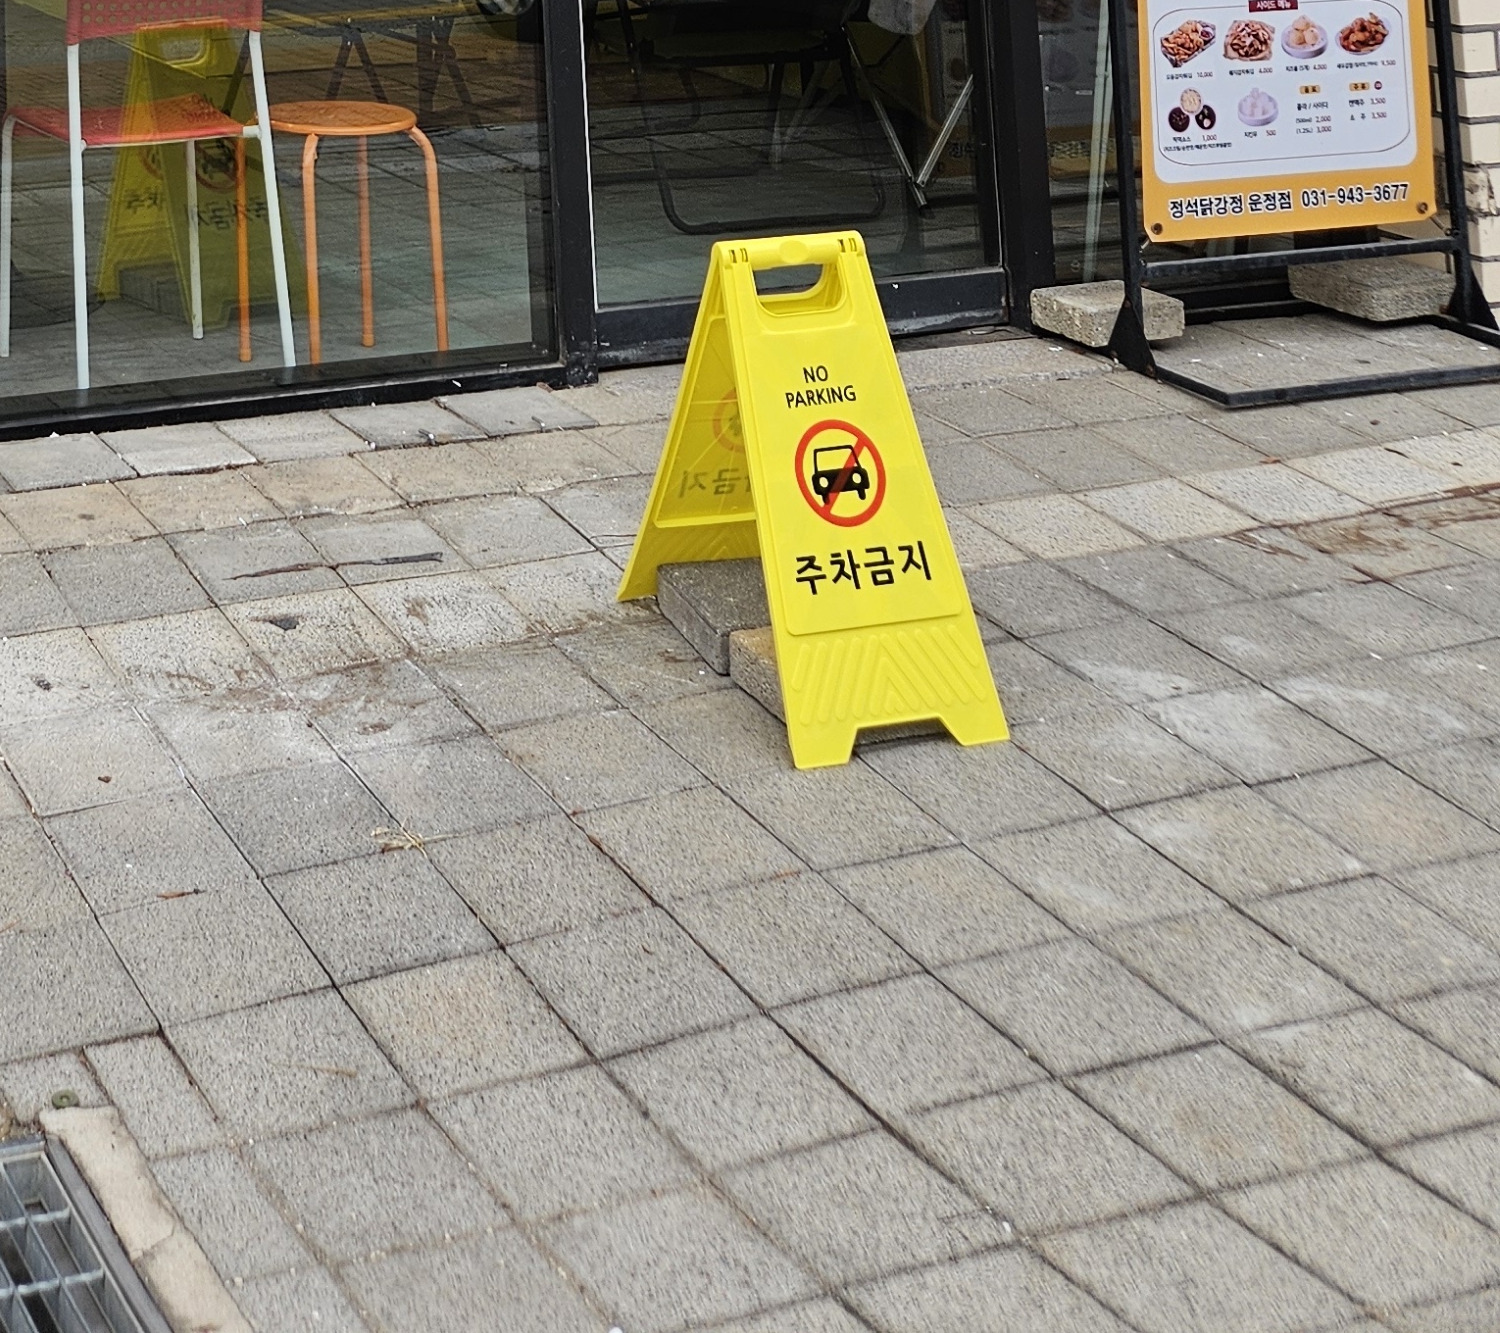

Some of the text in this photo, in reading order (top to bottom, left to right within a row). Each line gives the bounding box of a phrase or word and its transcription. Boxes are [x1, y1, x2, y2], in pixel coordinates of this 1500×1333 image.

[1256, 0, 1292, 9] 사이드 메뉴
[1169, 184, 1409, 218] 정석닭강정 운정점 031-943-3677
[803, 365, 828, 384] NO
[785, 385, 857, 409] PARKING
[795, 540, 931, 596] 주차금지
